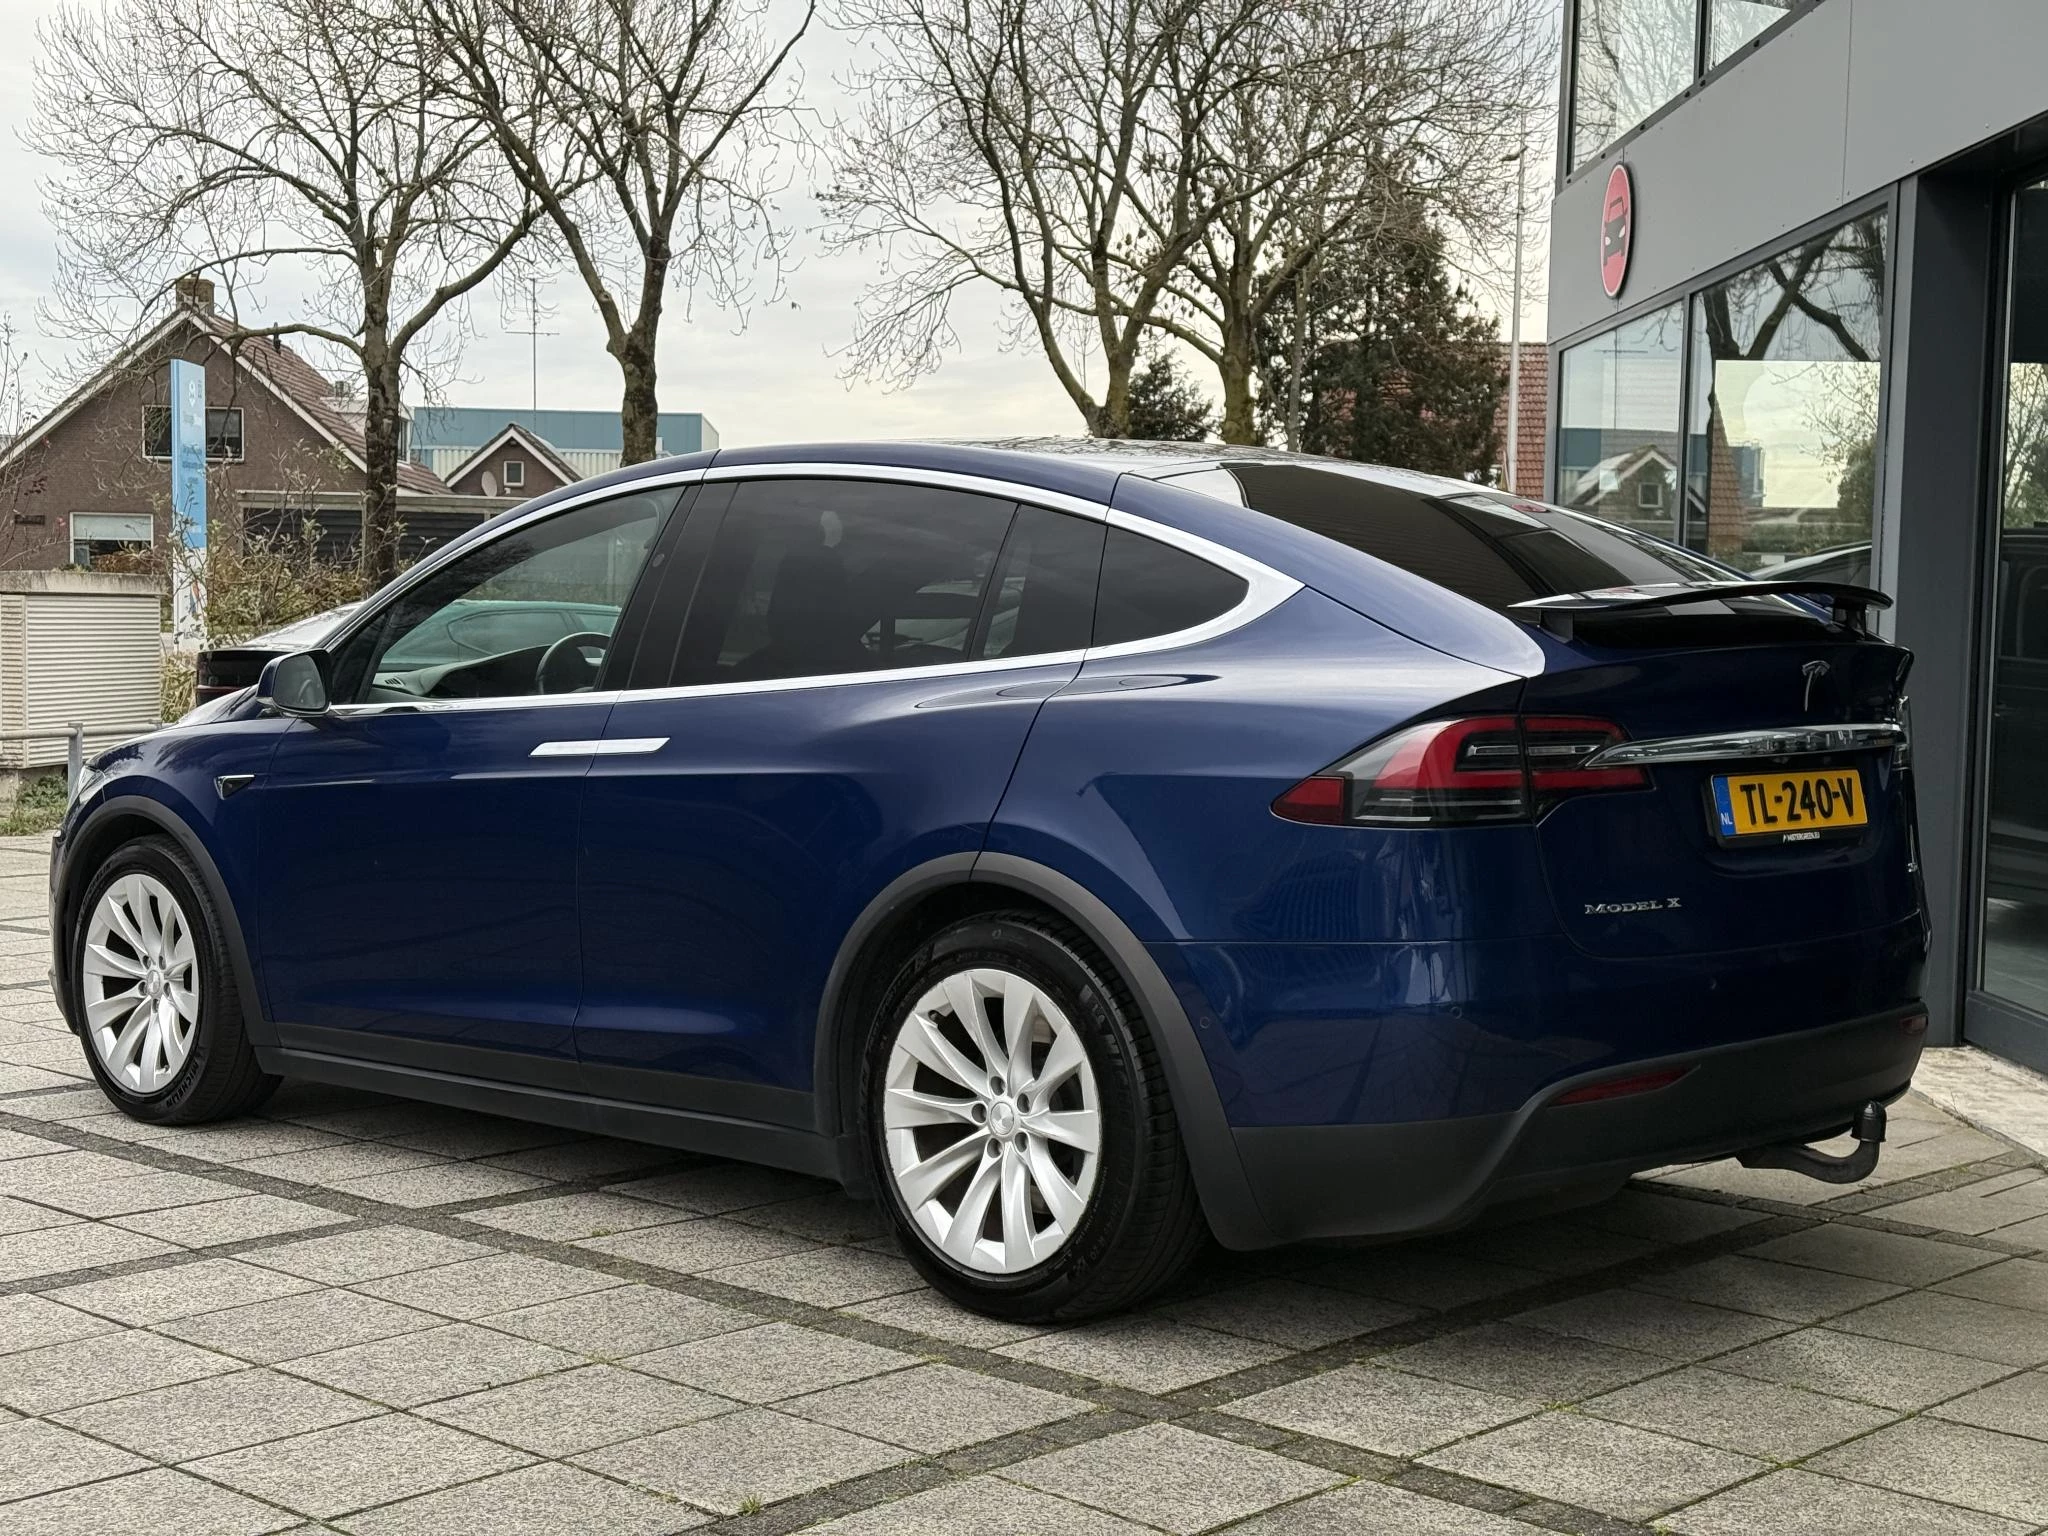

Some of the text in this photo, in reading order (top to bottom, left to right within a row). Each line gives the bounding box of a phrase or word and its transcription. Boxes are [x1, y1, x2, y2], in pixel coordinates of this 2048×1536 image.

[1739, 777, 1854, 825] TL-240-V
[1720, 812, 1733, 826] NL
[1584, 897, 1682, 915] MODEL X
[166, 1060, 199, 1108] MICHELIN
